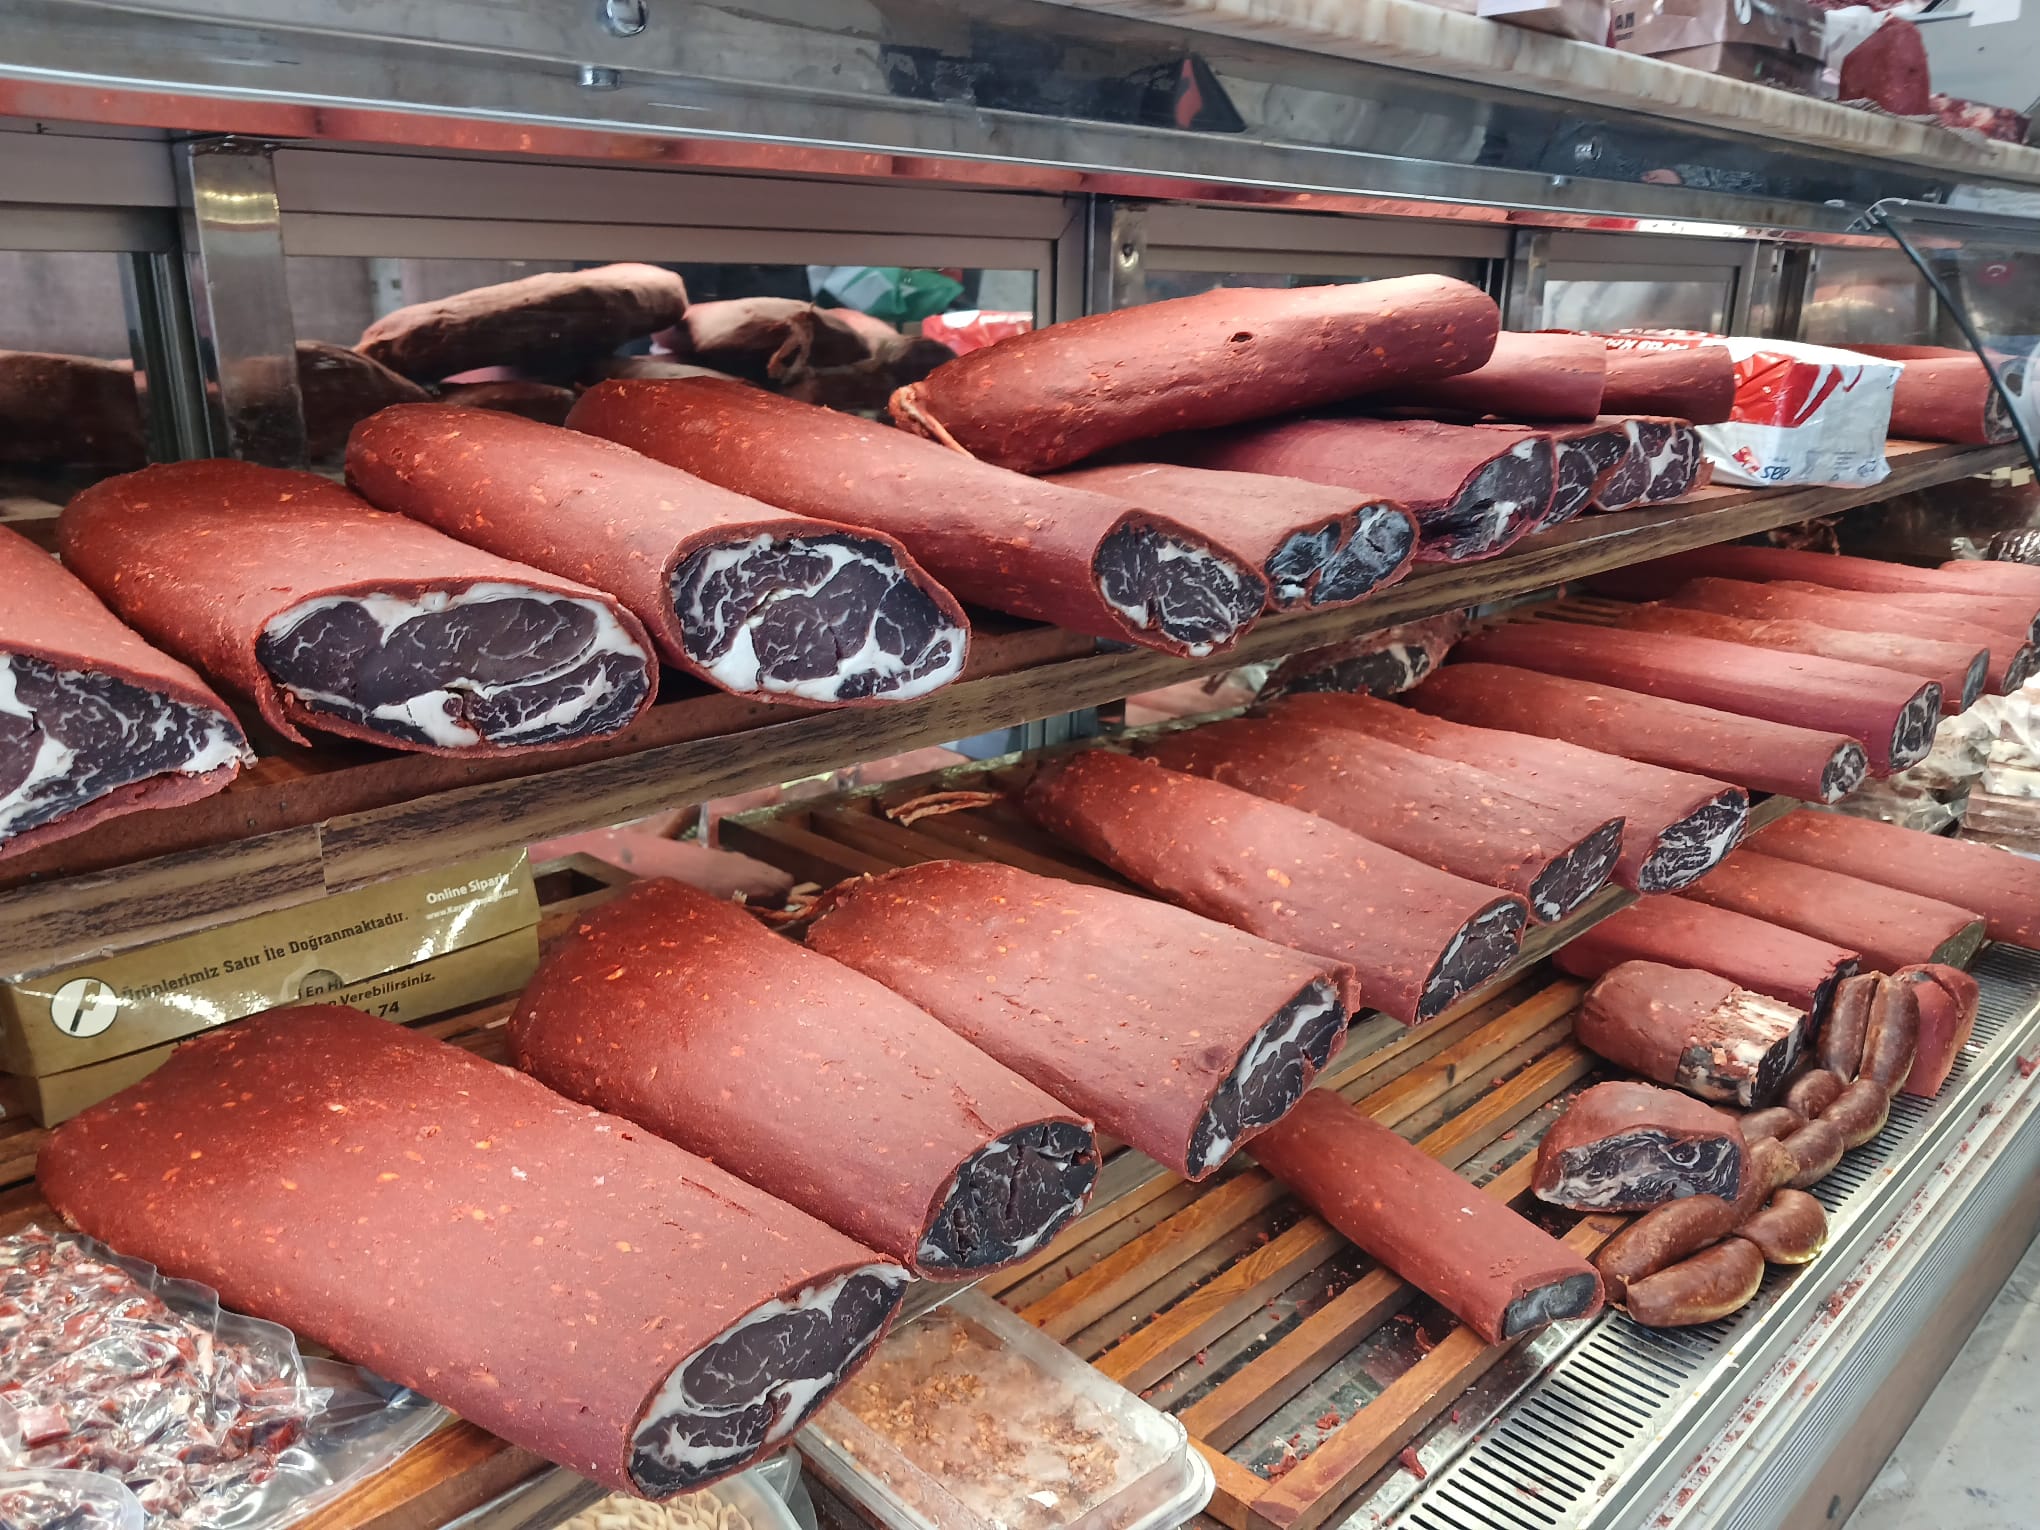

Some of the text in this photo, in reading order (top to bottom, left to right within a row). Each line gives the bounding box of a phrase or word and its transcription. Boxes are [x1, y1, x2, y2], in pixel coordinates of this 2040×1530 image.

[426, 886, 467, 904] Online
[122, 911, 409, 1001] Ürünlerimiz Satır İle Doğranmaktadır.
[306, 986, 324, 998] En
[340, 972, 436, 1005] Verebilirsiniz.
[378, 1001, 400, 1018] 74
